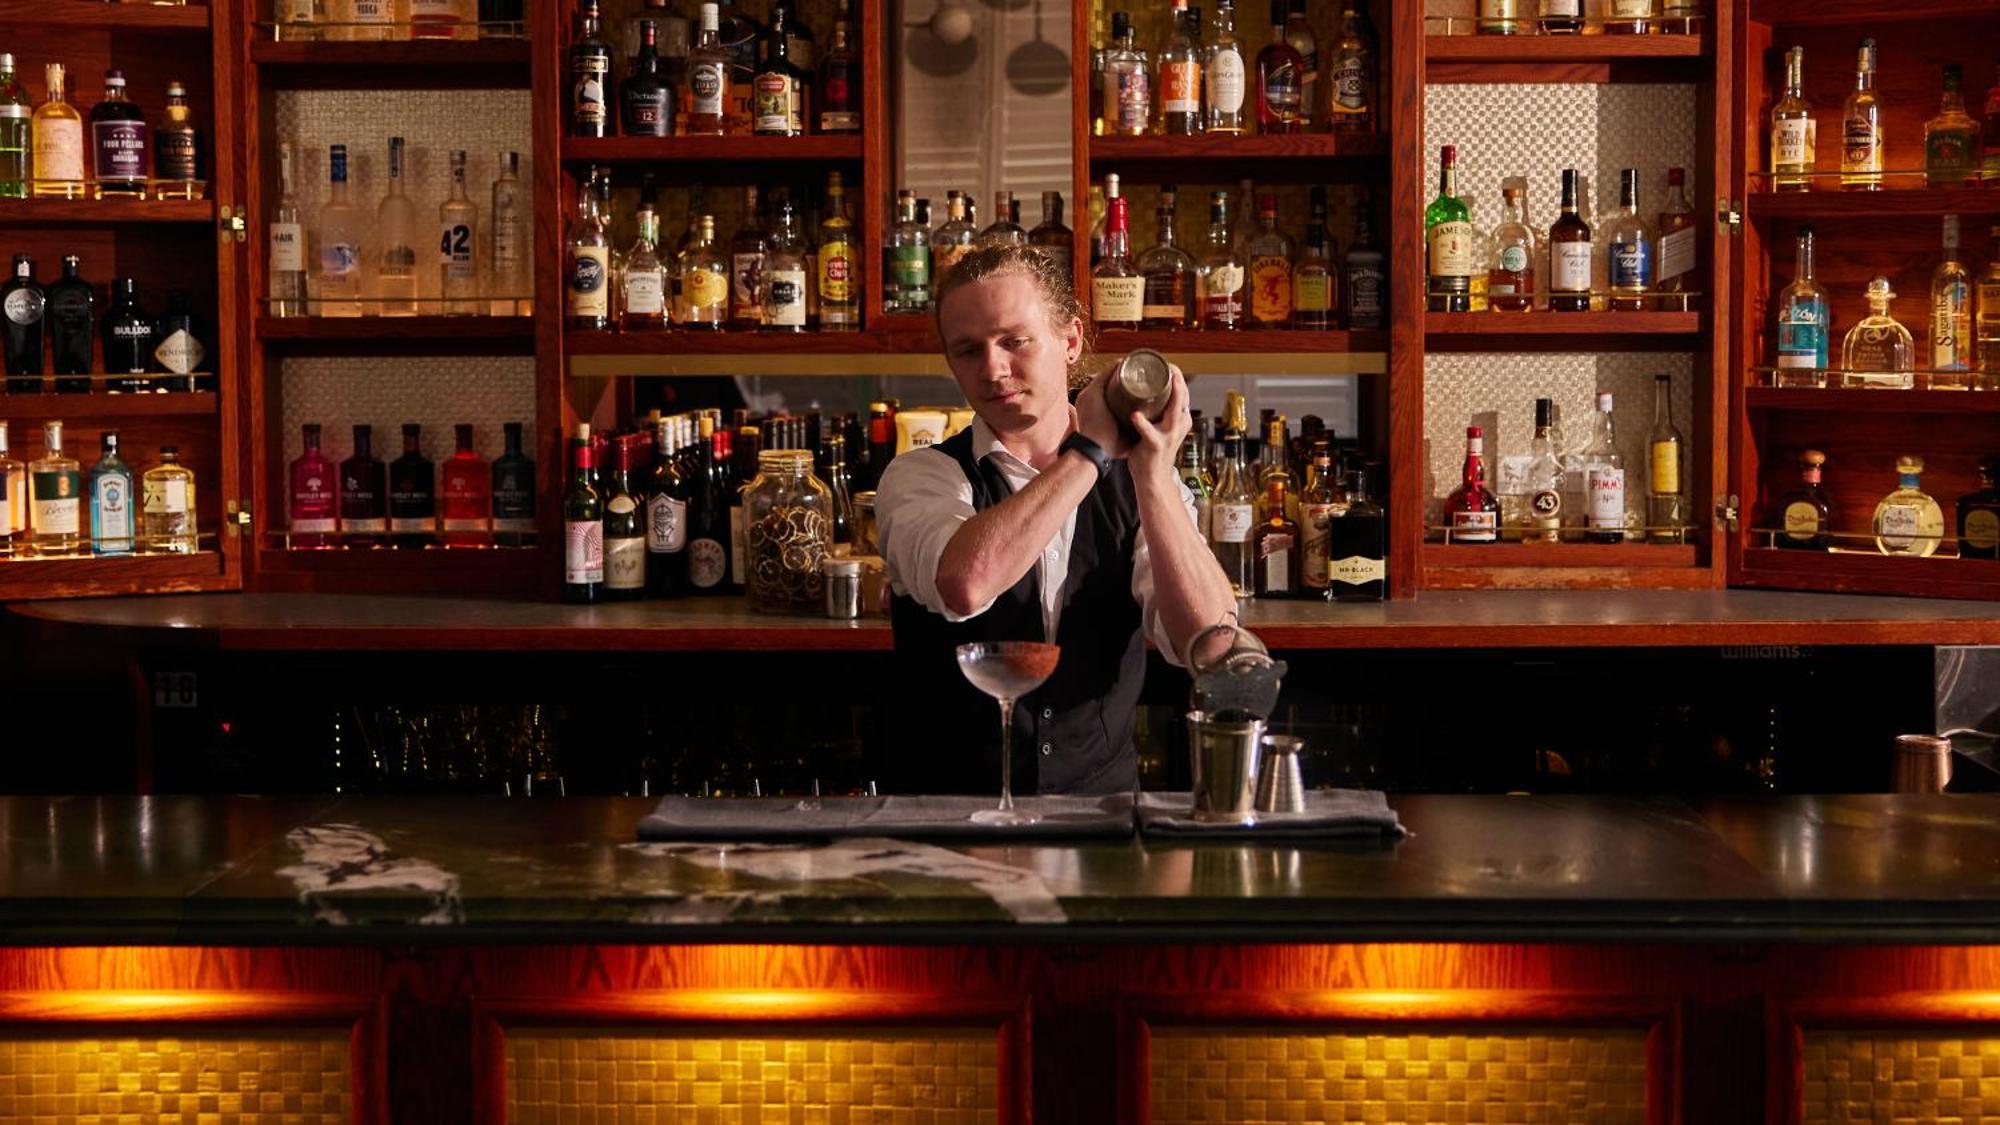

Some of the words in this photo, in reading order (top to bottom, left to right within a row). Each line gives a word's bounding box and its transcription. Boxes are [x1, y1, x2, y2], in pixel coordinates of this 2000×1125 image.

[441, 225, 469, 256] 42
[1096, 280, 1138, 291] Maker's
[1107, 290, 1137, 299] Mark
[913, 439, 934, 447] REAL
[1536, 495, 1555, 509] 43
